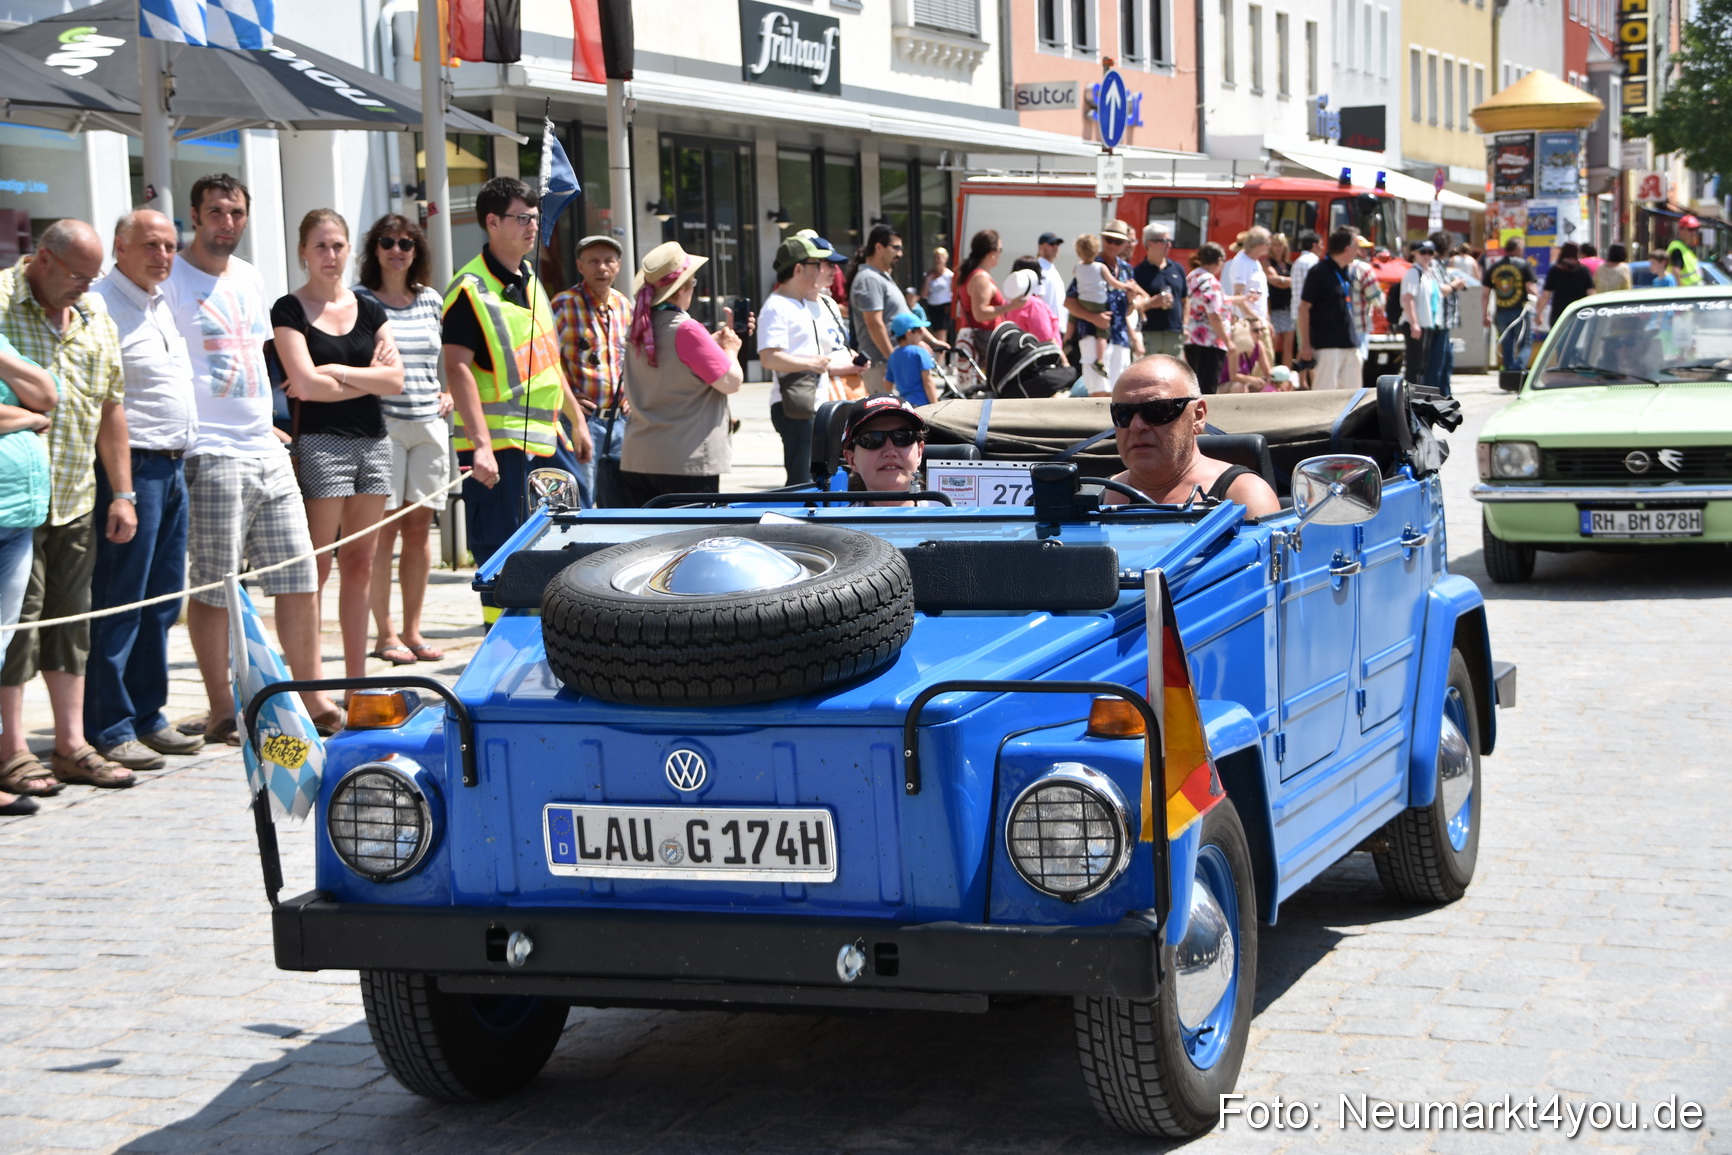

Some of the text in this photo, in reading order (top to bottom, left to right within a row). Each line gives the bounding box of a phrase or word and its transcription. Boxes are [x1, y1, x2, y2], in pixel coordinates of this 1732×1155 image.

[1592, 513, 1615, 530] RH
[1628, 513, 1651, 530] BM
[1656, 511, 1701, 530] 878H
[559, 815, 828, 865] D LAU G 174H
